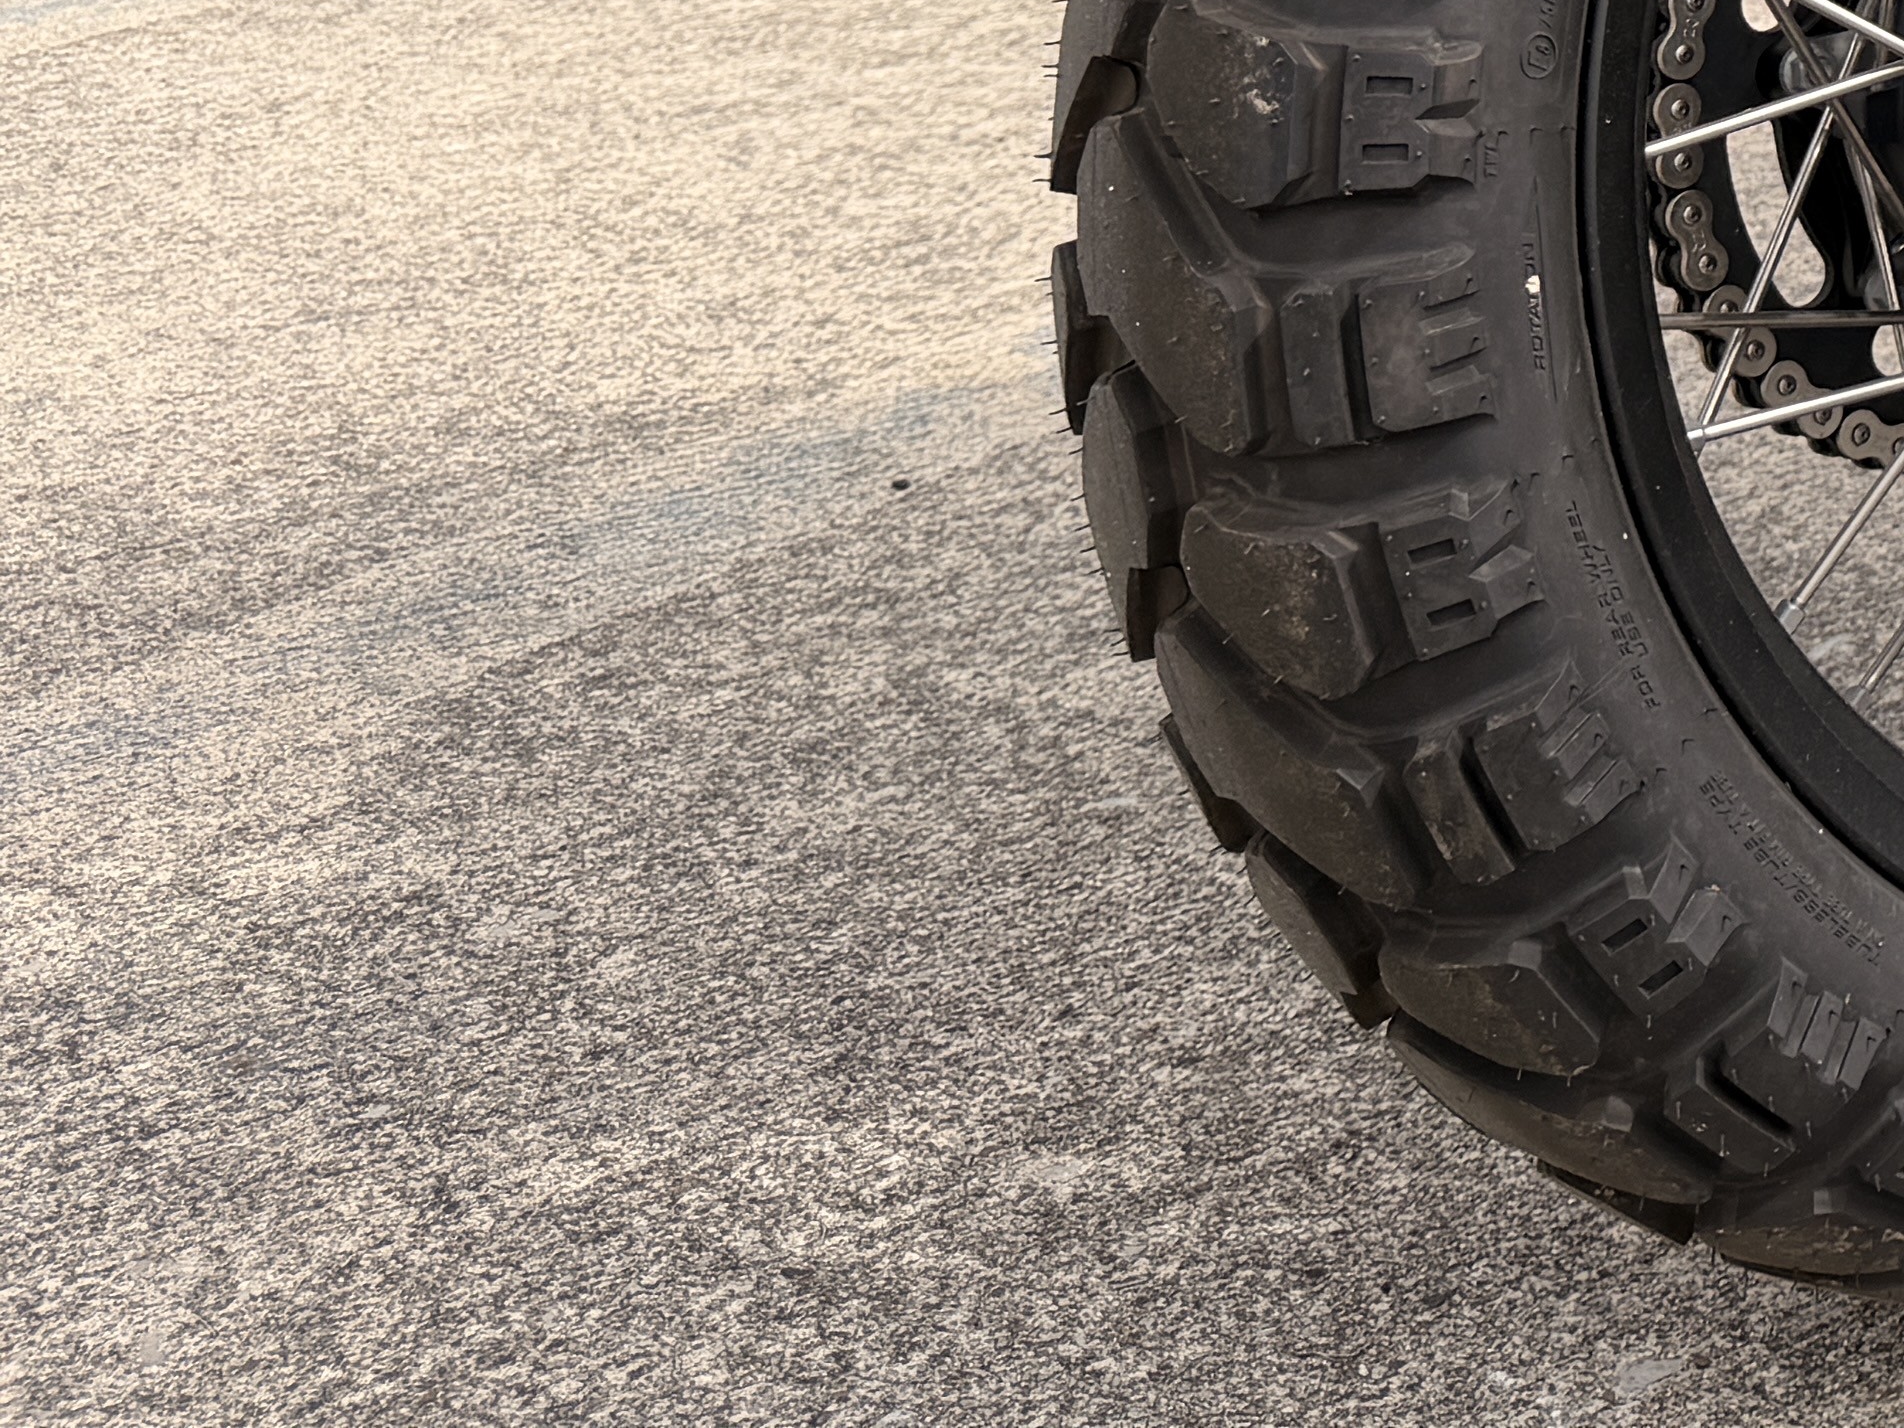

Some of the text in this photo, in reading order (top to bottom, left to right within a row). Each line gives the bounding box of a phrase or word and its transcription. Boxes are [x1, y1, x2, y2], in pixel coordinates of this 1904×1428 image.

[1522, 243, 1546, 372] ROTATON
[1564, 499, 1662, 710] FOR REAR WHEEL
[1591, 544, 1650, 658] USE ONLY
[1700, 778, 1882, 967] TUBELESS/TUBE TYPE
